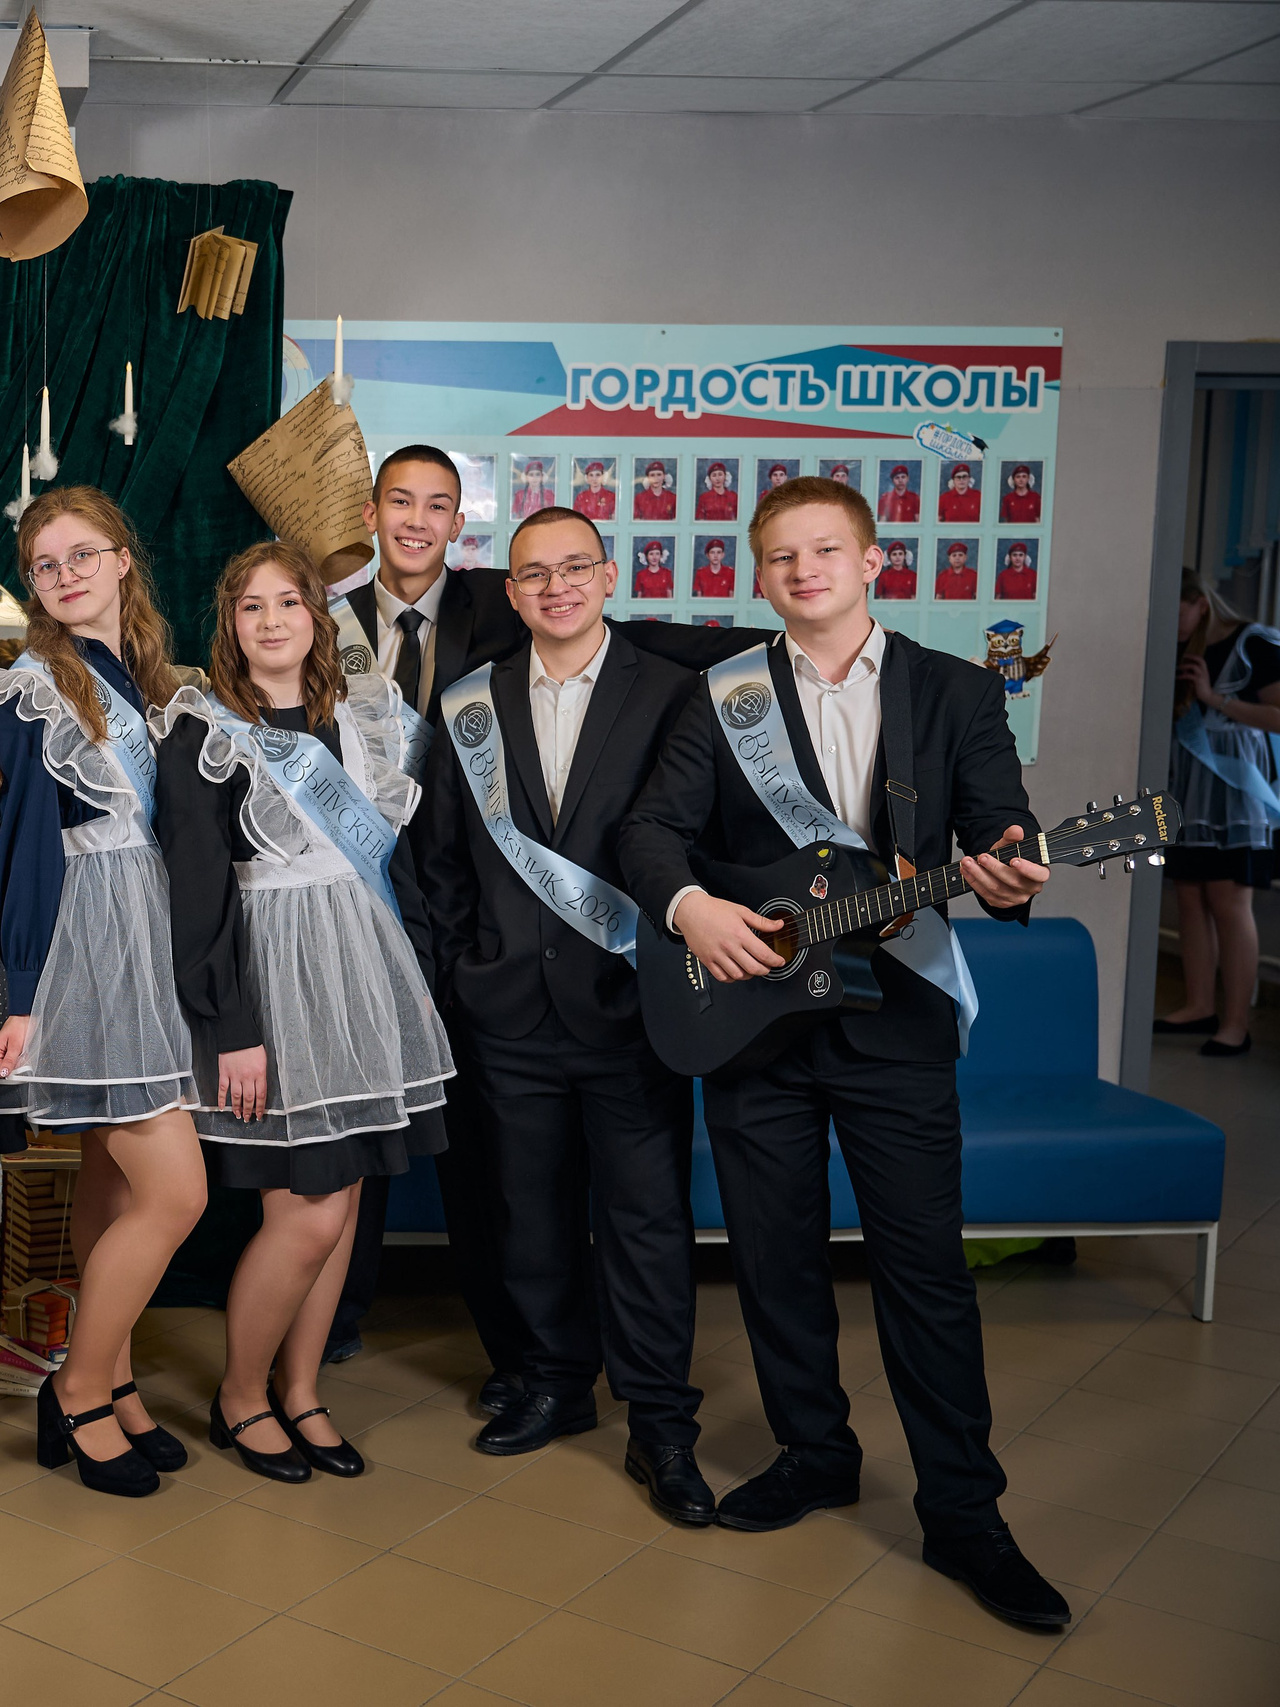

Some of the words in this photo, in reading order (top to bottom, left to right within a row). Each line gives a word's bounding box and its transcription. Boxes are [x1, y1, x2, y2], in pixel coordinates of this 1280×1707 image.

[570, 365, 825, 413] ГОРДОСТЬ
[840, 366, 1041, 411] ШКОЛЫ
[470, 747, 570, 911] ВЫПУСКНИК
[565, 886, 623, 933] 2026
[1152, 795, 1168, 842] Rockstar
